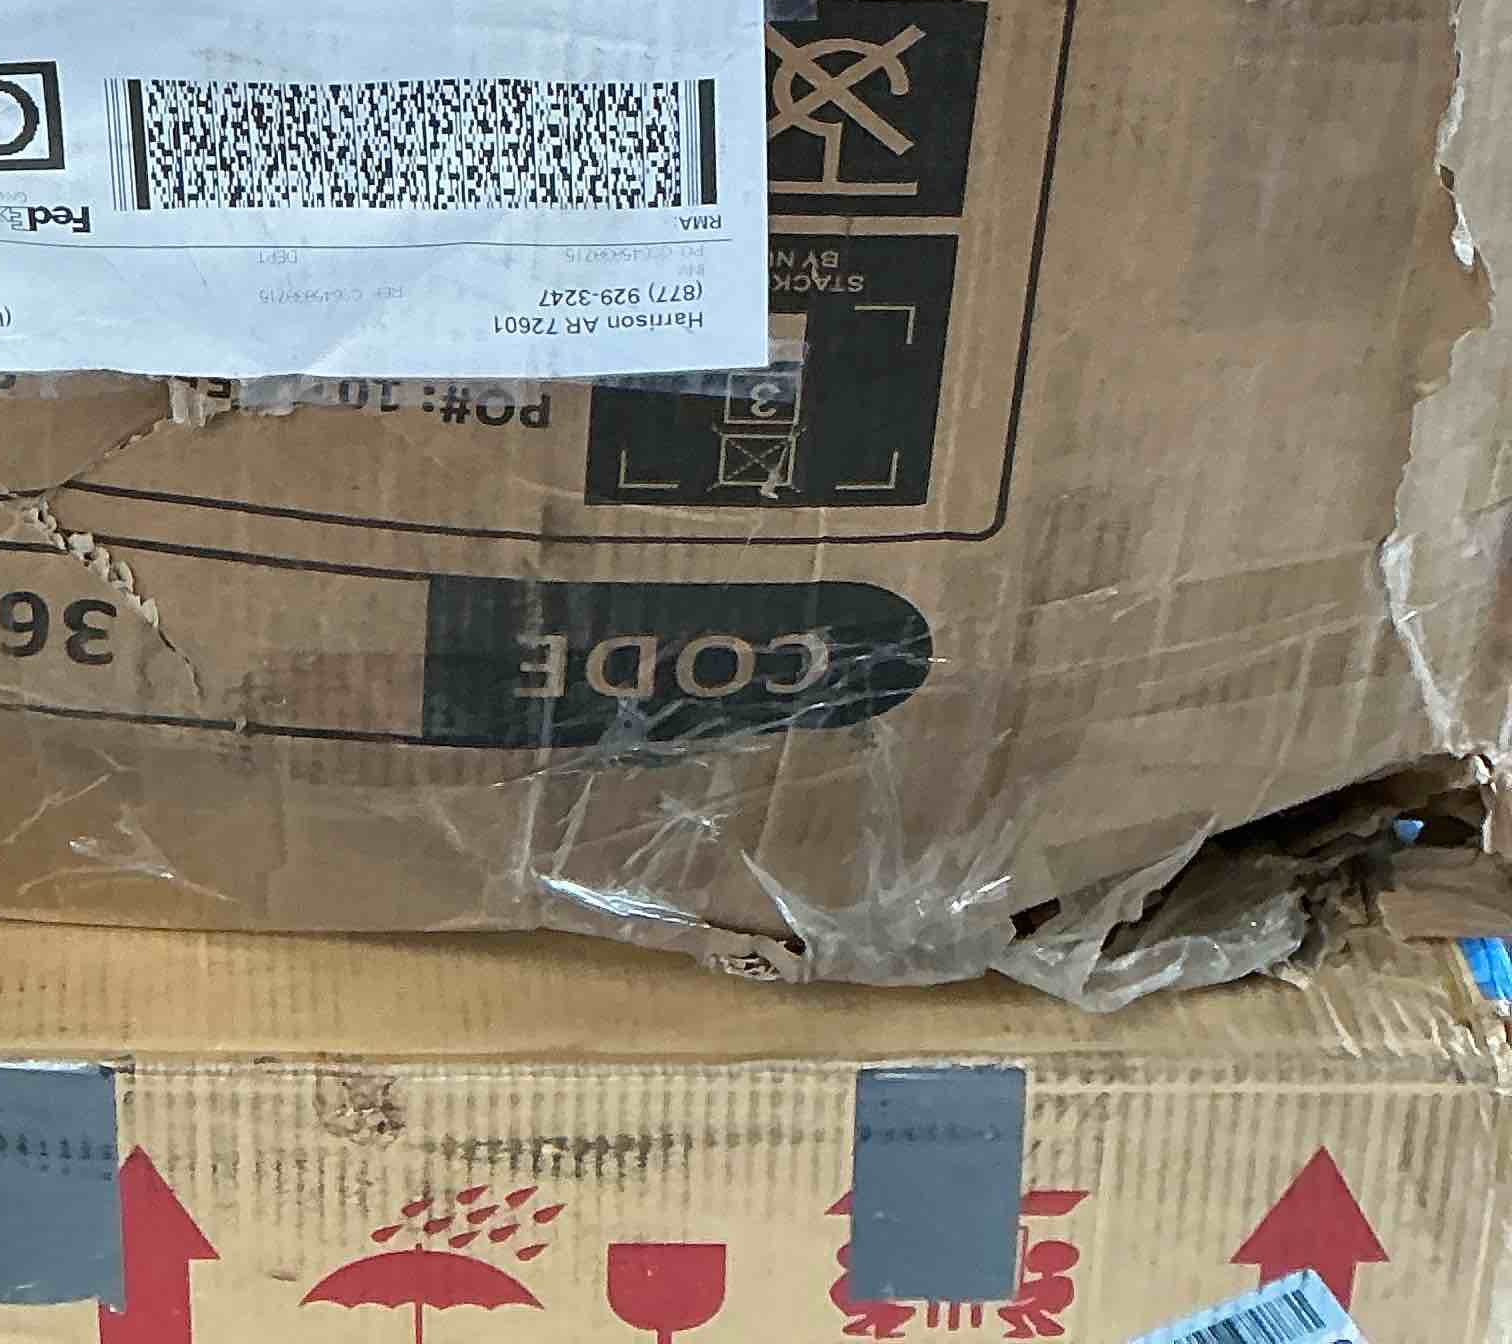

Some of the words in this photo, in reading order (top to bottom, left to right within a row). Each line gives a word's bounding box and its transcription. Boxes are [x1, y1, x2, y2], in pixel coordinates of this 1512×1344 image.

[648, 281, 703, 303] (877)
[768, 272, 865, 293] STACK
[538, 287, 640, 307] 929-3247
[493, 316, 558, 335] 72601
[565, 316, 599, 334] AR
[607, 311, 703, 332] Harrison
[514, 632, 830, 700] CODE
